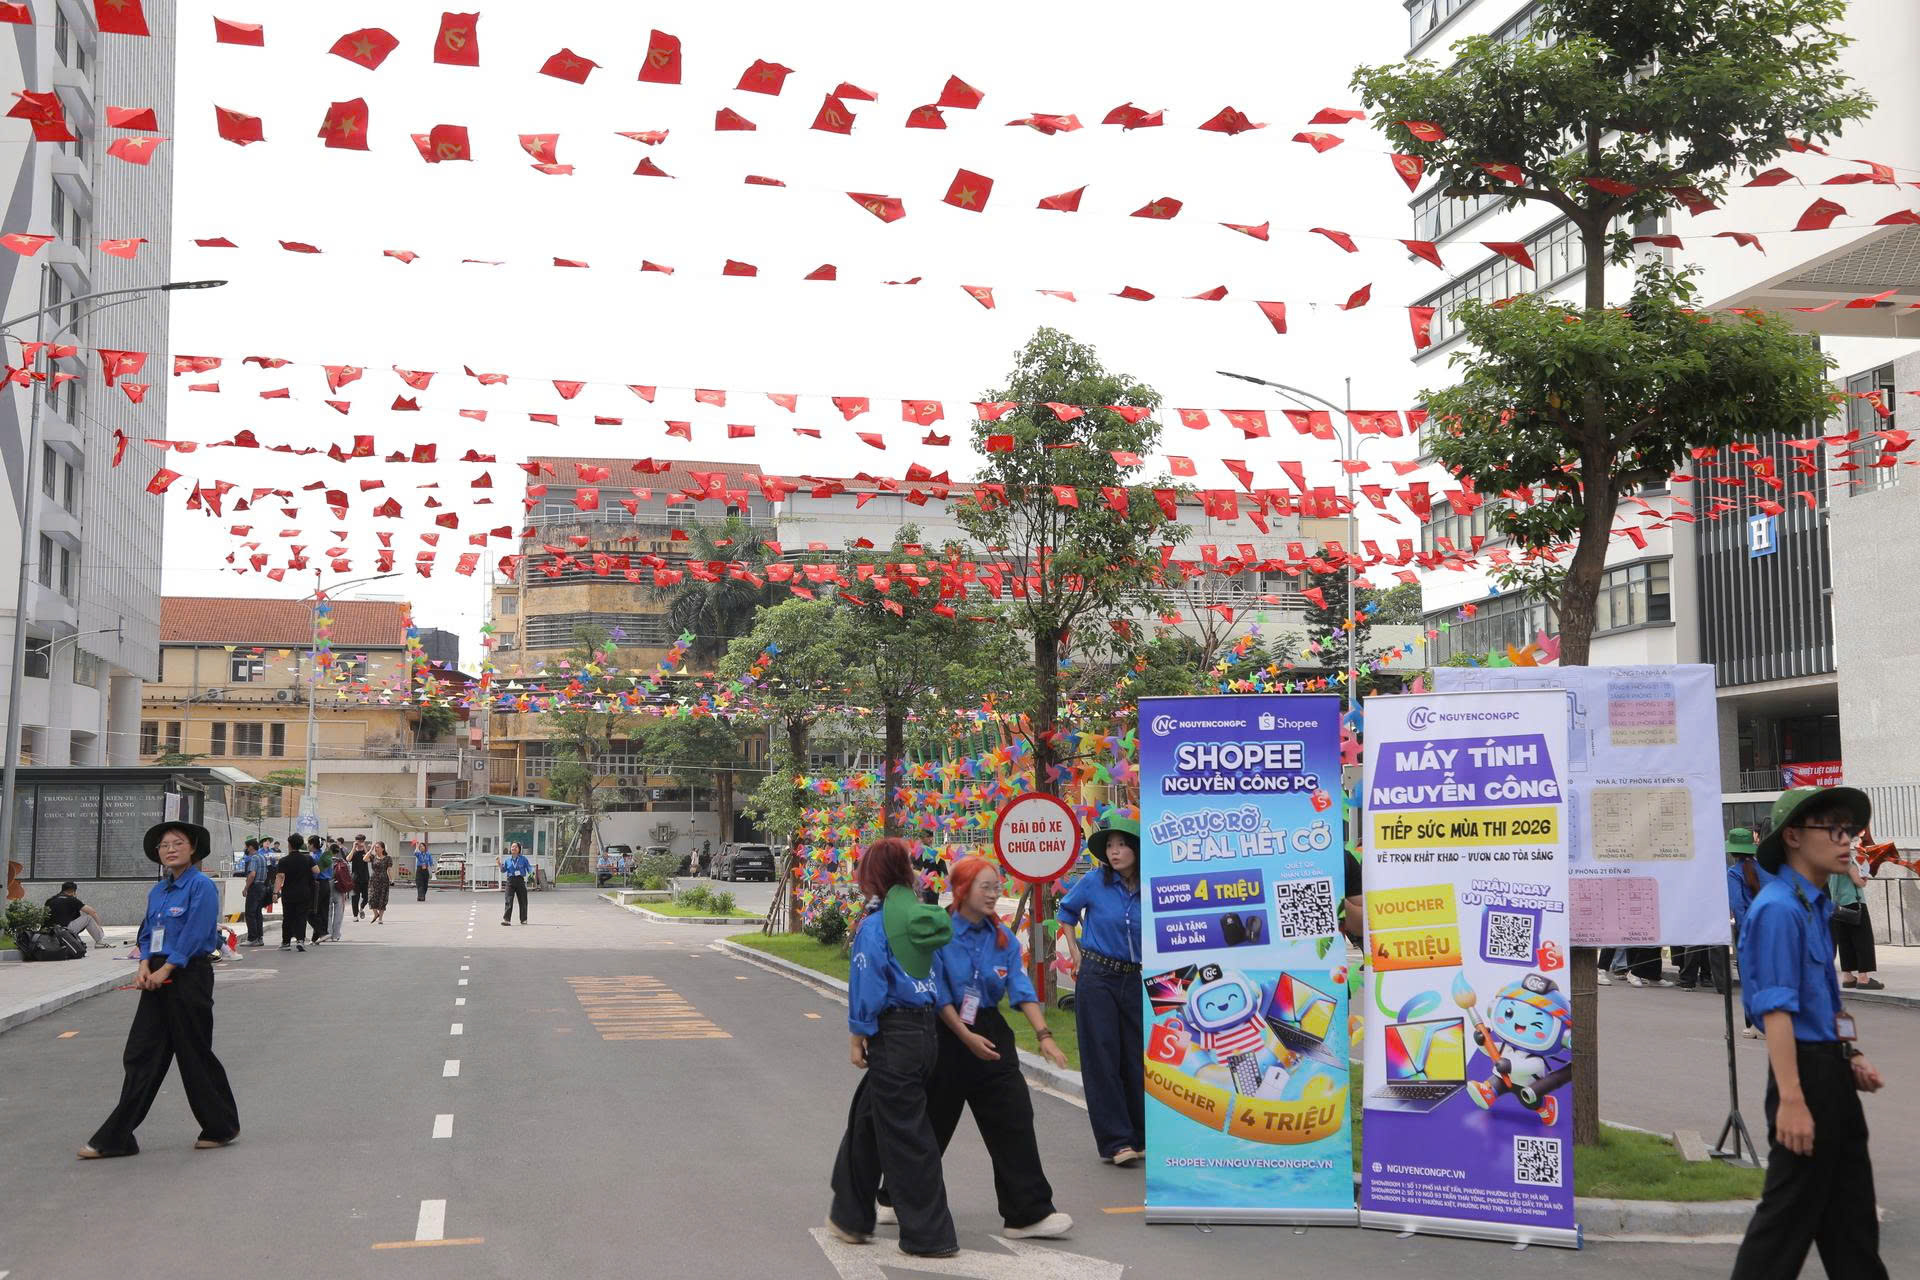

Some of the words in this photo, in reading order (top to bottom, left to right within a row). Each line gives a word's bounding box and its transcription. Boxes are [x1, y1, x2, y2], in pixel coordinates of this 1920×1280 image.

[1750, 518, 1769, 550] H
[1180, 720, 1246, 729] NGUYENCONGPC
[1278, 718, 1318, 731] Shopee
[1440, 712, 1520, 722] NGUYENCONGPC
[1178, 744, 1302, 770] SHOPEE
[1396, 742, 1459, 772] MÁY
[1468, 738, 1538, 768] TÍNH
[1164, 772, 1236, 792] NGUYỄN
[1240, 774, 1289, 791] CÔNG
[1294, 776, 1317, 790] PC
[1374, 772, 1476, 806] NGUYỄN
[1484, 774, 1558, 800] CÔNG
[1596, 776, 1610, 784] NHÀ
[1619, 776, 1629, 784] TỪ
[1630, 776, 1652, 784] PHÒNG
[1662, 776, 1676, 784] ĐẾN
[1011, 820, 1028, 834] BÃI
[1032, 816, 1046, 832] ĐỖ
[1049, 820, 1062, 832] XE
[1152, 814, 1180, 842] HÈ
[1181, 812, 1224, 837] RỰC
[1226, 808, 1258, 831] RỠ
[1381, 815, 1412, 840] TIẾP
[1418, 819, 1446, 840] SỨC
[1450, 818, 1479, 838] MÙA
[1483, 822, 1506, 837] THI
[1512, 820, 1551, 836] 2026
[1008, 838, 1036, 853] CHỮA
[1039, 836, 1066, 852] CHÁY
[1171, 836, 1236, 862] DEAL
[1240, 820, 1286, 857] HẾT
[1390, 853, 1412, 864] TRỌN
[1414, 850, 1435, 862] KHÁT
[1438, 852, 1459, 862] KHAO
[1468, 852, 1492, 862] VƯƠN
[1494, 852, 1510, 862] CAO
[1531, 848, 1554, 860] SÁNG
[1574, 866, 1598, 874] PHÒNG
[1156, 884, 1191, 894] VOUCHER
[1194, 880, 1208, 901] 4
[1214, 878, 1260, 901] TRIỆU
[1472, 878, 1510, 894] NHẬN
[1512, 882, 1550, 896] NGAY
[1159, 894, 1192, 905] LAPTOP
[1376, 898, 1444, 915] VOUCHER
[1484, 893, 1508, 906] ĐÃI
[1510, 898, 1564, 912] SHOPEE
[1166, 922, 1184, 932] QUÀ
[1185, 920, 1208, 932] TẶNG
[1378, 944, 1390, 958] 4
[1392, 935, 1450, 960] TRIỆU
[1144, 1069, 1216, 1112] VOUCHER
[1240, 1108, 1256, 1126] 4
[1264, 1104, 1336, 1135] TRIỆU
[1166, 1158, 1333, 1169] SHOPEE.VN/NGUYENCONGPC.VN
[1387, 1164, 1466, 1180] NGUYENCONGPC.VN
